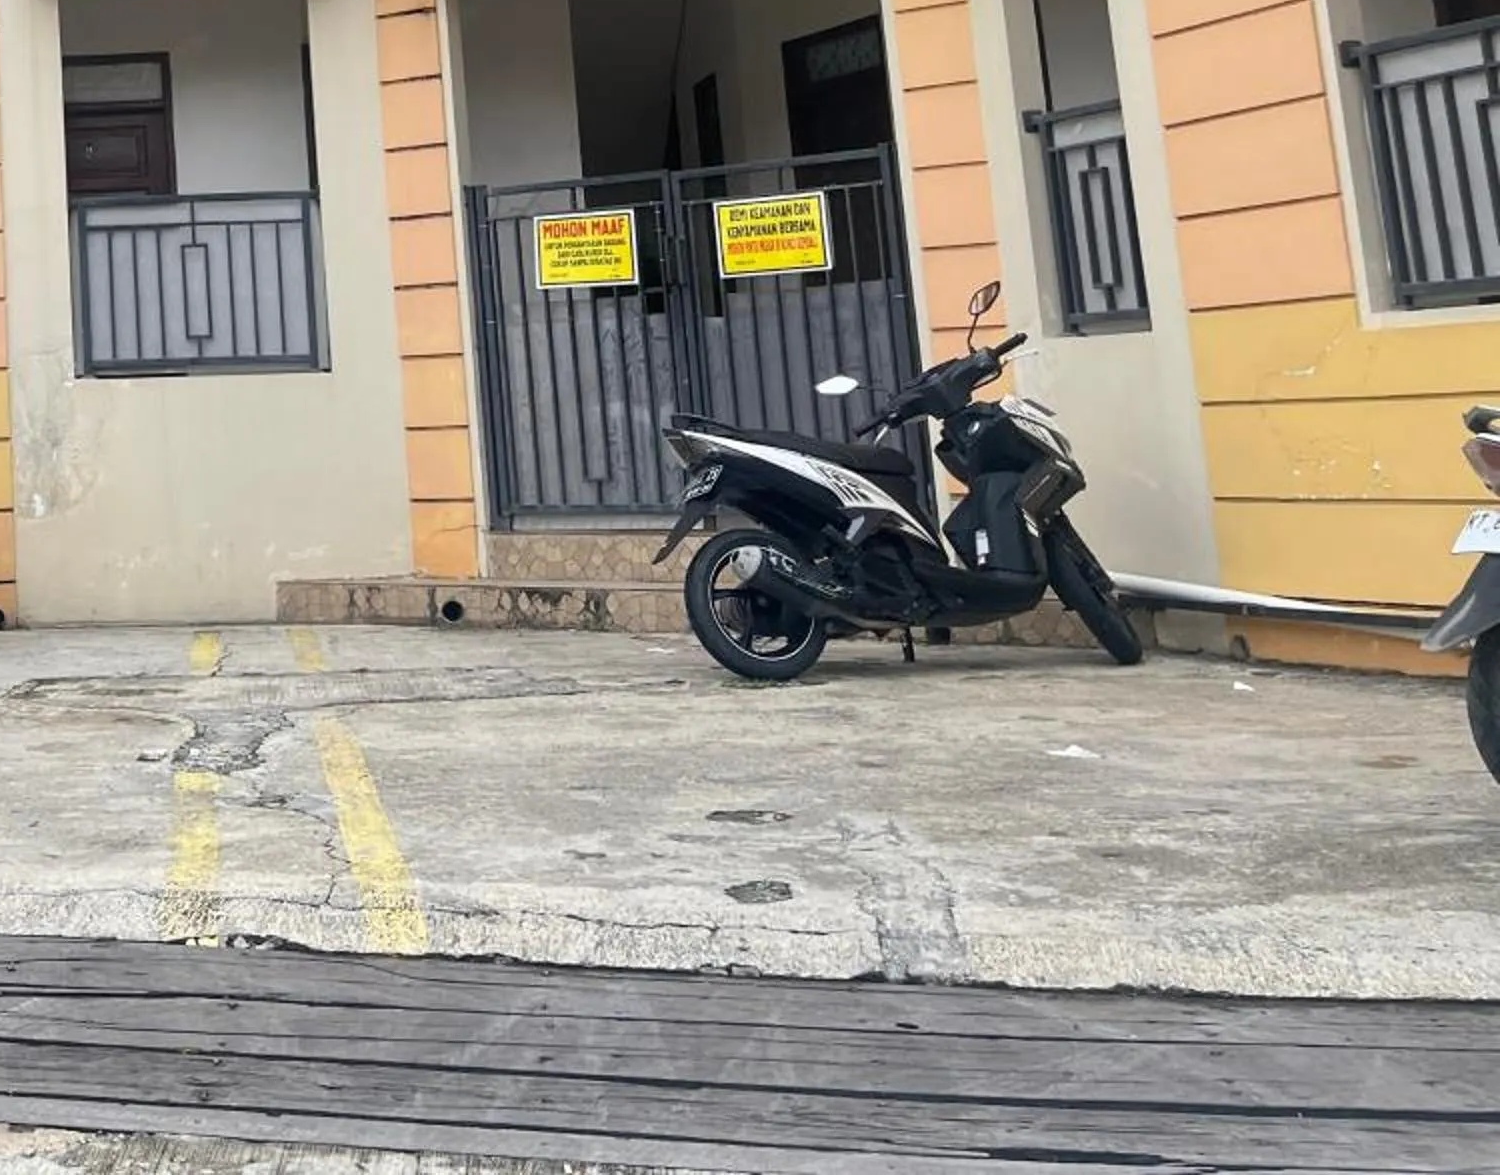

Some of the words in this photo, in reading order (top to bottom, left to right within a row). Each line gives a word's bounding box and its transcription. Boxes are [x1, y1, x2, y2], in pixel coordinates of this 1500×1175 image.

[749, 204, 793, 219] KEAMANAN
[543, 221, 587, 239] MOHON
[591, 217, 624, 236] MAAF
[727, 223, 777, 238] KENYAMANAN
[779, 219, 816, 234] BERSAMA
